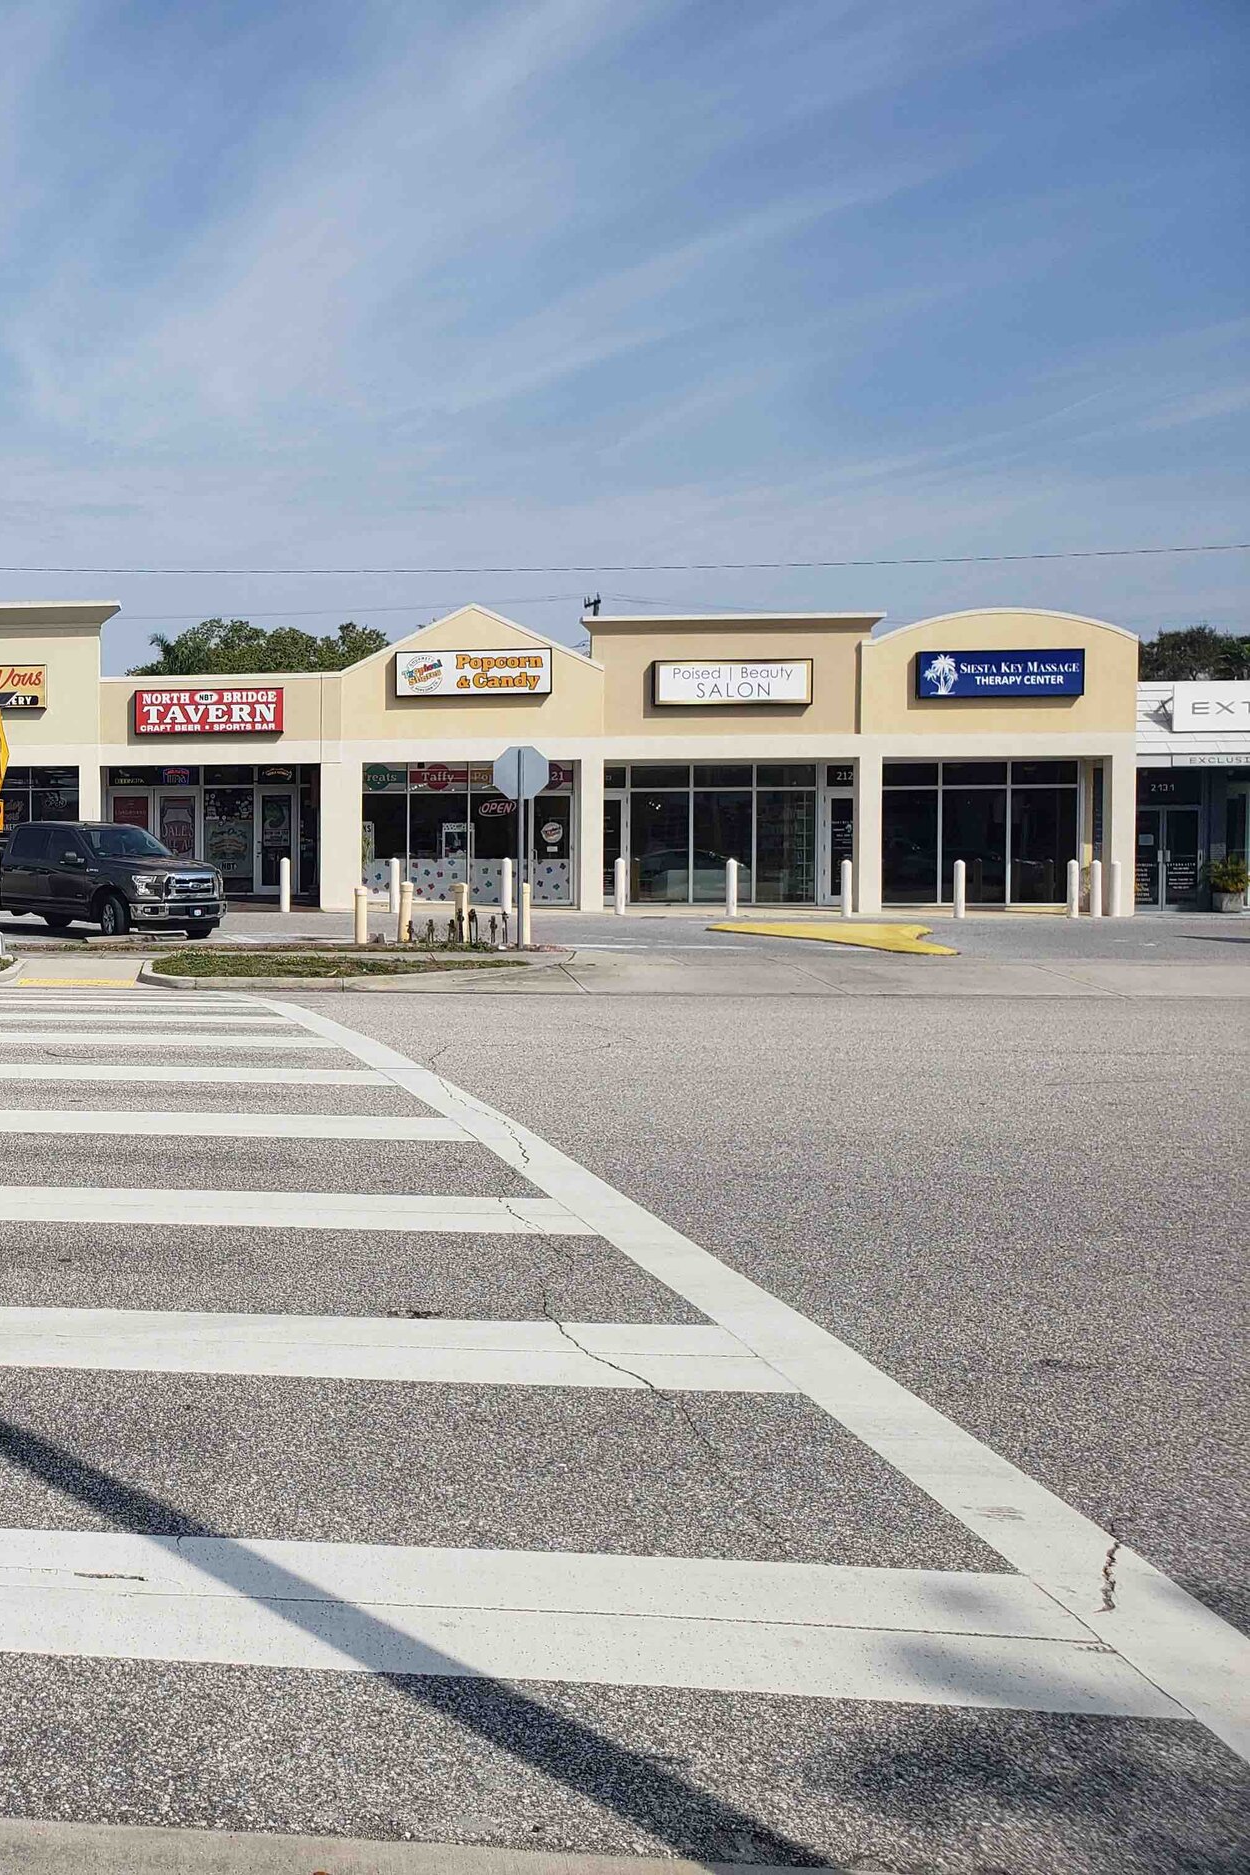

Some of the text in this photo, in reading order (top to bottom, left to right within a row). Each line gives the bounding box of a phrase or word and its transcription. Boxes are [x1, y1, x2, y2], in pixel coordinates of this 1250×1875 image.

[456, 654, 543, 672] Popcorn
[672, 667, 721, 680] Poised
[741, 666, 793, 680] Beauty
[975, 675, 1064, 685] THERAPY CENTER
[457, 672, 541, 690] & Candy
[696, 681, 771, 698] SALON
[142, 691, 277, 705] NORTH NBT BRIDGE
[142, 703, 276, 724] TAVERN
[366, 773, 398, 782] reats
[421, 771, 455, 784] Taffy
[1150, 784, 1175, 792] 2131
[481, 802, 513, 814] OPEN
